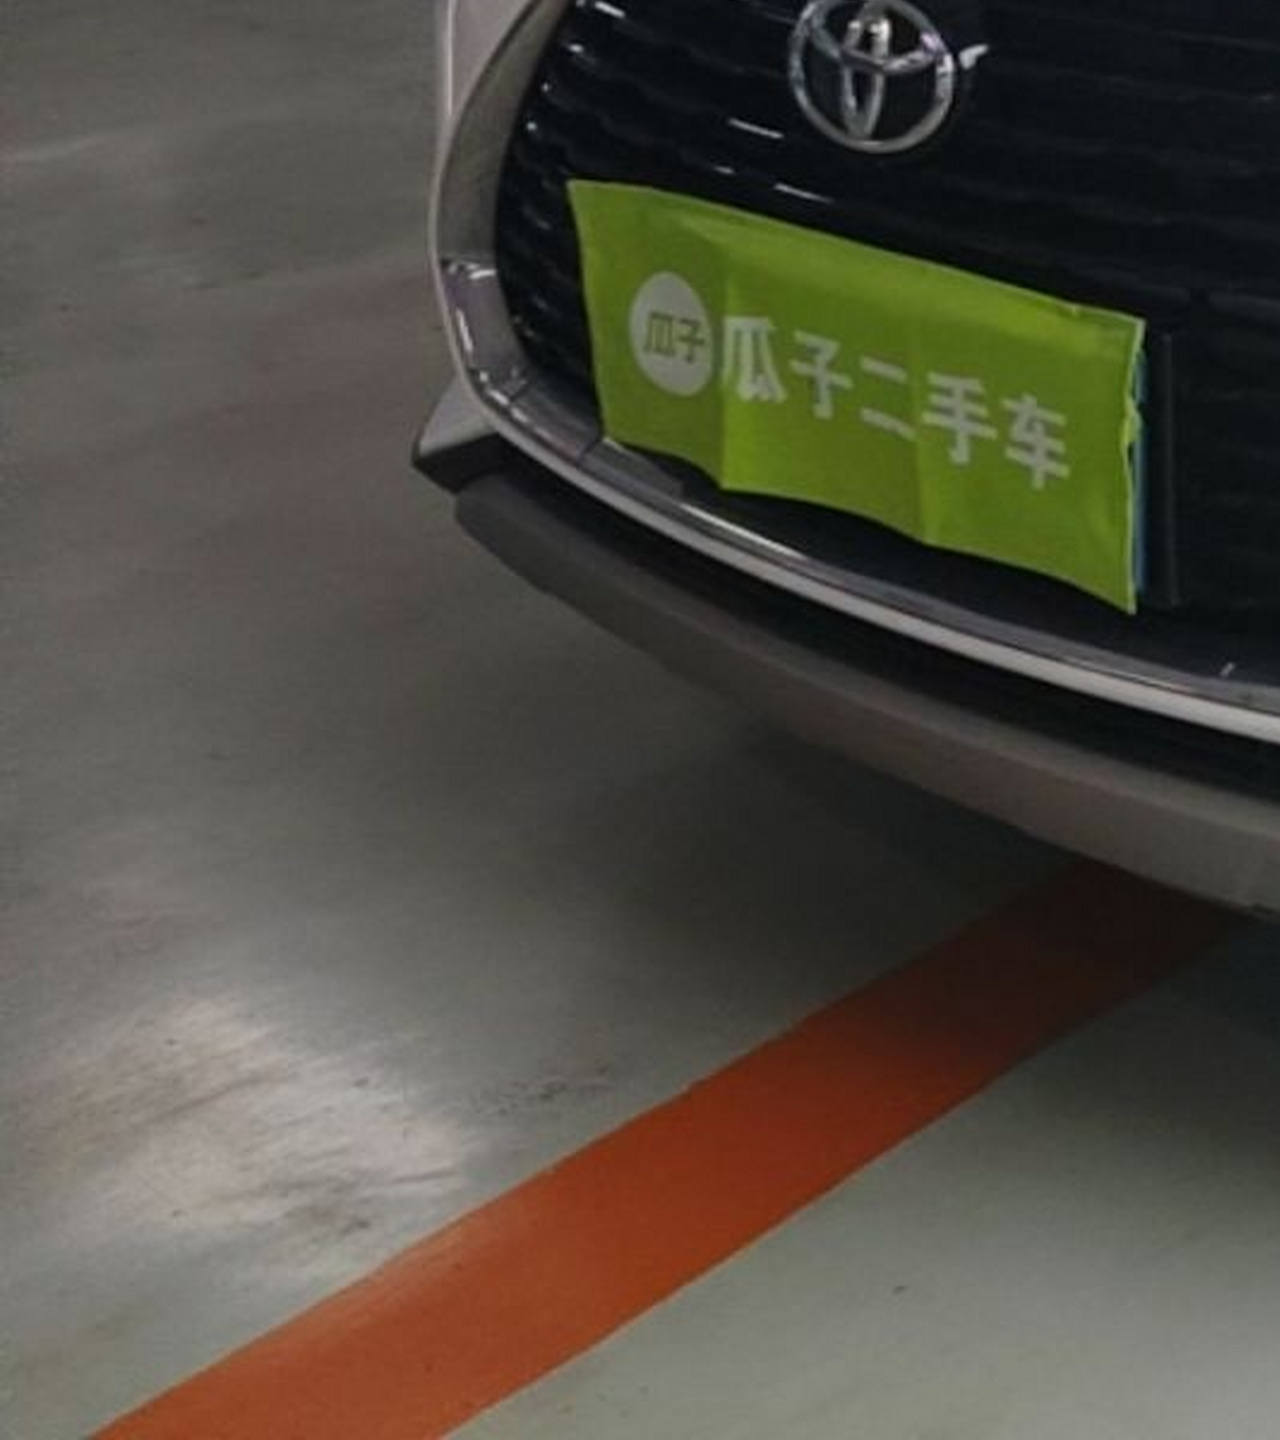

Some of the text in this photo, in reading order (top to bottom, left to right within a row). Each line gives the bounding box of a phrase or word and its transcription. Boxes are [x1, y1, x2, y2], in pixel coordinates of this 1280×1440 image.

[643, 311, 706, 363] 瓜子
[721, 316, 1070, 491] 瓜子二手车
